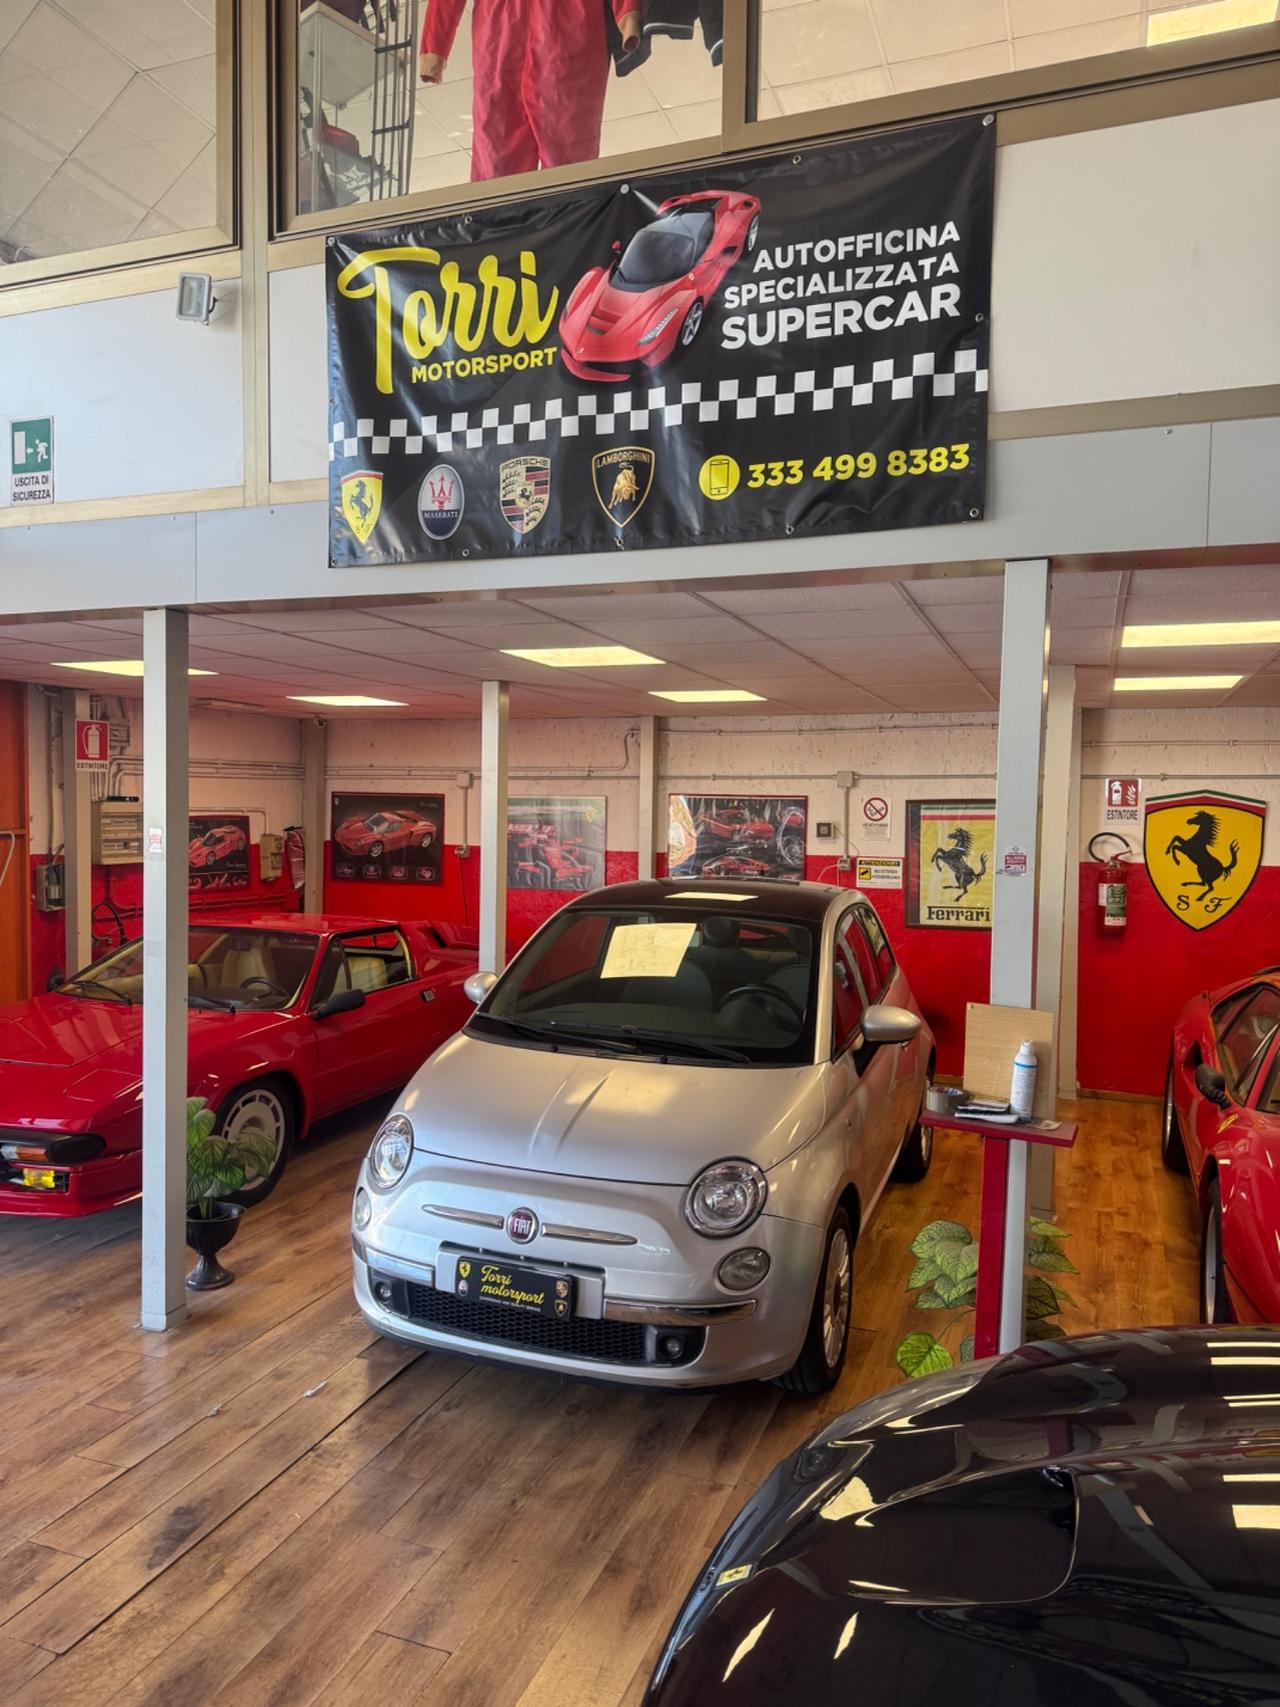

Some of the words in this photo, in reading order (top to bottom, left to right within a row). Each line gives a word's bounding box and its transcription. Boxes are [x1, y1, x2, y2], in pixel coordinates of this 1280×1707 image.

[753, 221, 960, 273] AUTOFFICINA
[724, 252, 960, 309] SPECIALIZZATA
[337, 246, 559, 394] Torri
[720, 283, 961, 349] SUPERCAR
[411, 347, 557, 383] MOTORSPORT
[501, 458, 549, 470] PORSCHE
[597, 450, 650, 468] LAMBORGHINI
[747, 459, 804, 488] 333
[813, 452, 877, 481] 499
[888, 443, 970, 476] 8383
[15, 475, 40, 487] USCITA
[41, 474, 49, 485] DI
[12, 489, 51, 501] SICUREZZA
[423, 511, 458, 519] MASERATI
[76, 762, 108, 770] ESTINTORE
[1107, 809, 1138, 820] ESTINTORE
[1176, 894, 1190, 911] S
[1204, 896, 1233, 913] F
[926, 906, 992, 922] Ferrari
[513, 1218, 531, 1235] FIAT
[480, 1264, 512, 1285] Torri
[480, 1285, 545, 1304] motorsport
